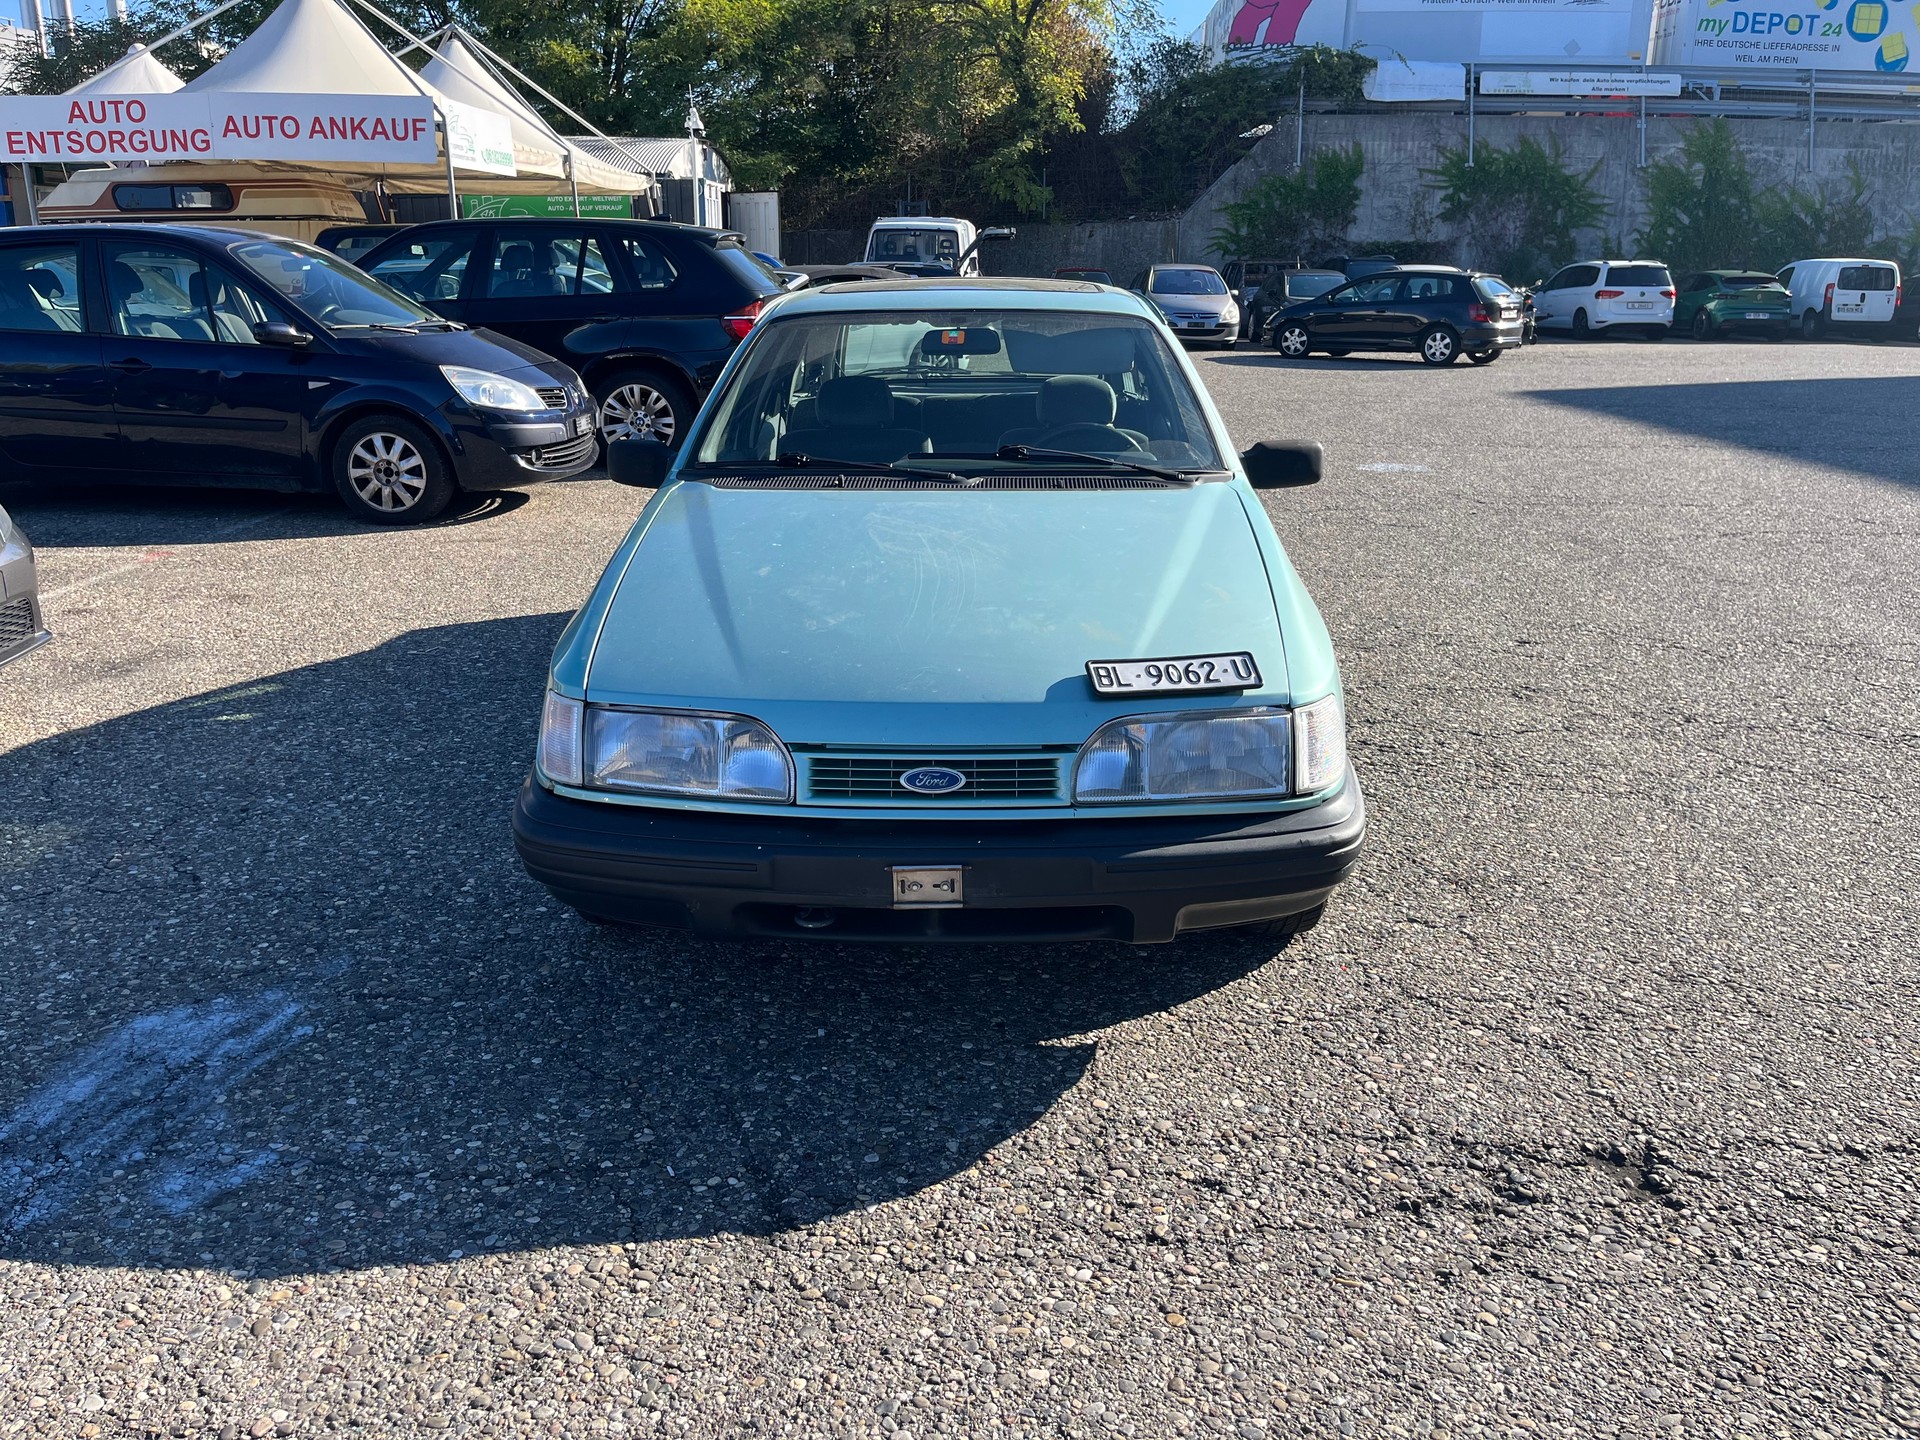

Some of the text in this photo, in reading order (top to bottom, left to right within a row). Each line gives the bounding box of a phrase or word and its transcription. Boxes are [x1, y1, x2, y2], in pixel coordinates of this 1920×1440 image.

[1697, 11, 1844, 37] my DEPOT 24
[1694, 39, 1841, 52] IHRE DEUTSCHE LIEFERADRESSE IN
[1735, 54, 1799, 65] WEIL AM RHEIN
[67, 99, 147, 124] AUTO
[221, 115, 427, 142] AUTO ANKAUF
[6, 128, 212, 155] ENTSORGUNG
[594, 204, 624, 212] VERKAUF
[915, 772, 950, 786] Ford
